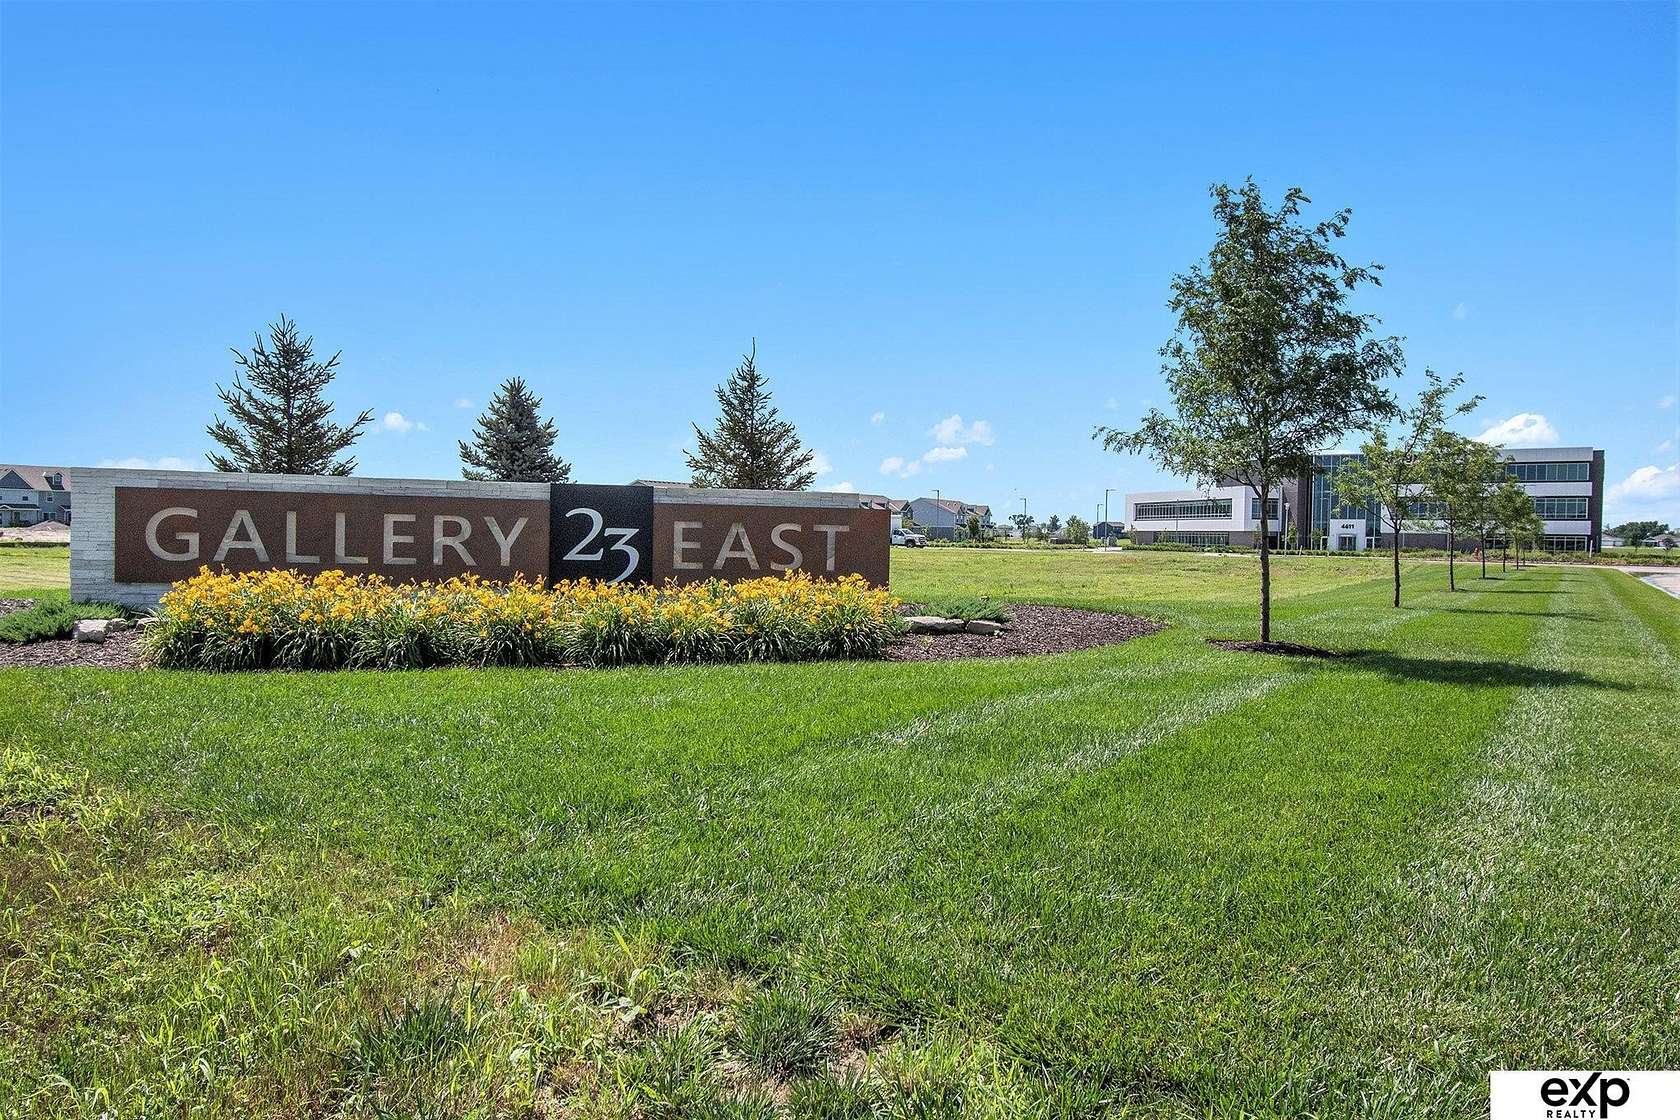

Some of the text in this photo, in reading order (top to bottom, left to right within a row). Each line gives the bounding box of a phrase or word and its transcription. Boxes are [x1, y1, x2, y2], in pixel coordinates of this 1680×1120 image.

[144, 506, 850, 585] GALLERY 23 EAST
